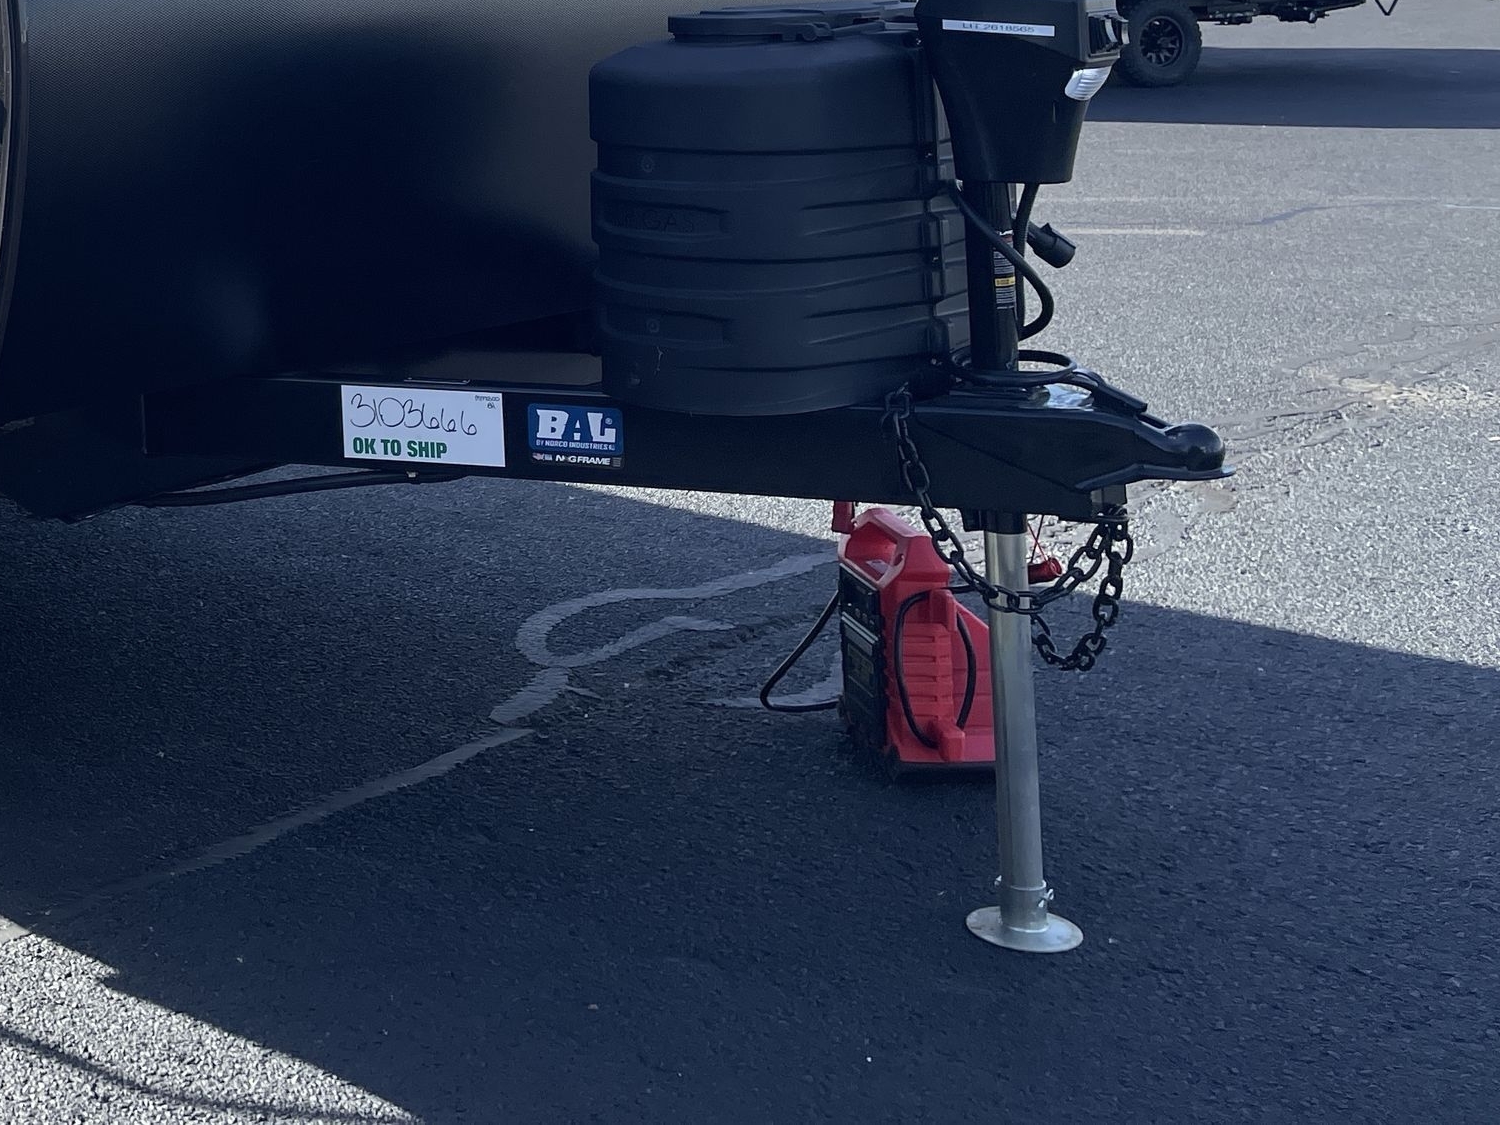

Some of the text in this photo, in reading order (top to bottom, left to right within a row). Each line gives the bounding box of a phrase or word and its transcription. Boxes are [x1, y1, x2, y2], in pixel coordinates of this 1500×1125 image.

[352, 437, 448, 459] OK TO SHIP
[544, 440, 568, 448] NORCO
[568, 441, 609, 451] INDUSTRIES
